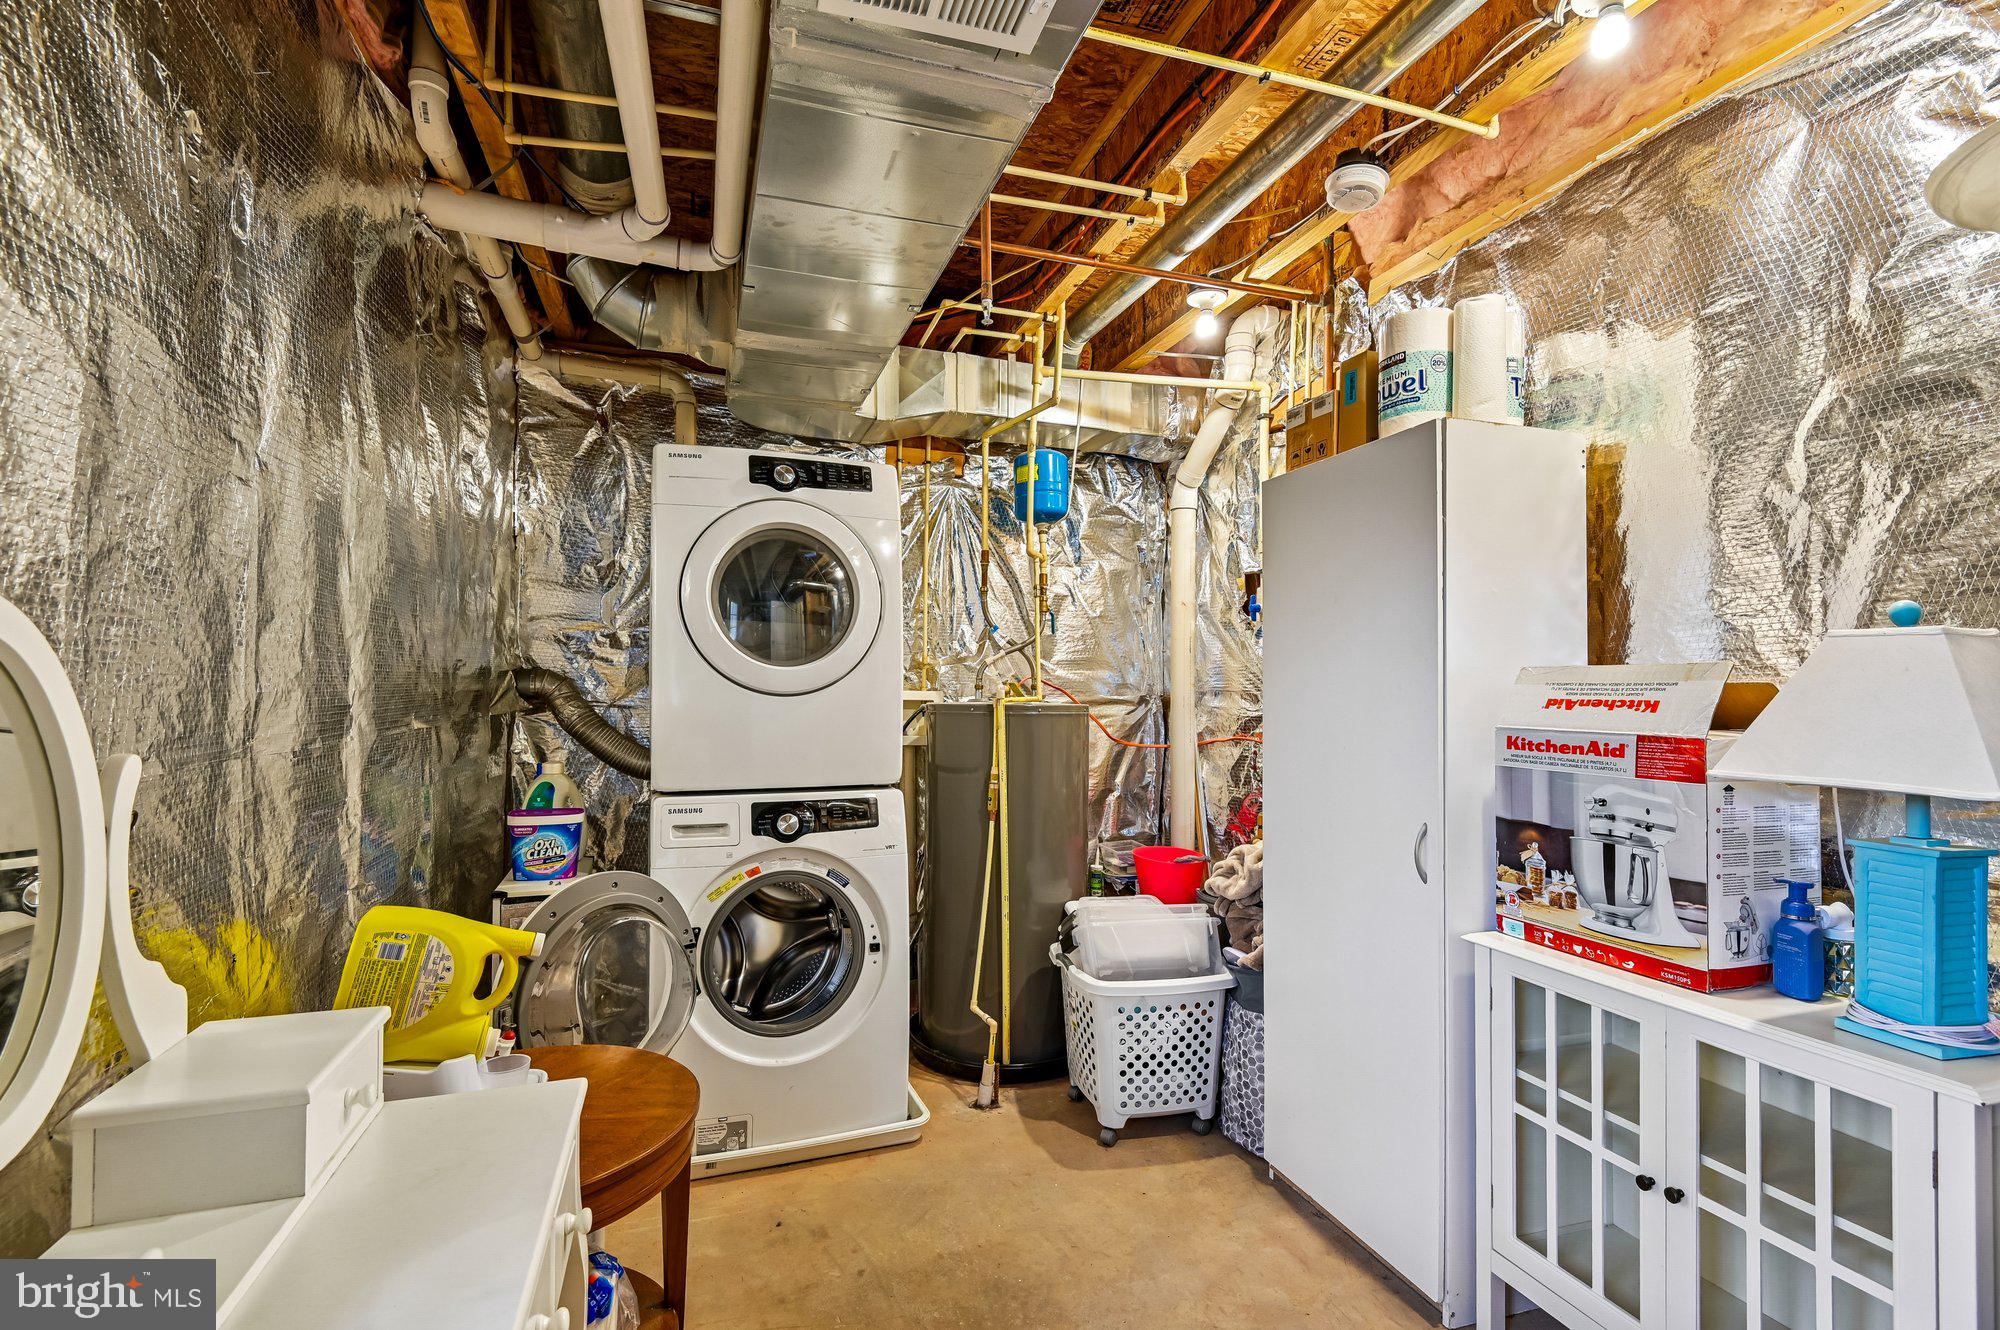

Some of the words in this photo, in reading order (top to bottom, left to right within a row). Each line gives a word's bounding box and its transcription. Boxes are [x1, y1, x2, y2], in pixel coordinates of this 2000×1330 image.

[1313, 49, 1340, 67] FEB
[1334, 36, 1352, 48] 10
[1432, 359, 1446, 367] 20%
[1378, 369, 1427, 402] wel
[1545, 698, 1661, 714] KitchenAid
[1506, 735, 1626, 759] KitchenAid
[667, 807, 703, 815] SAMSUNG
[534, 839, 555, 849] OXI
[526, 846, 562, 860] CLEAN
